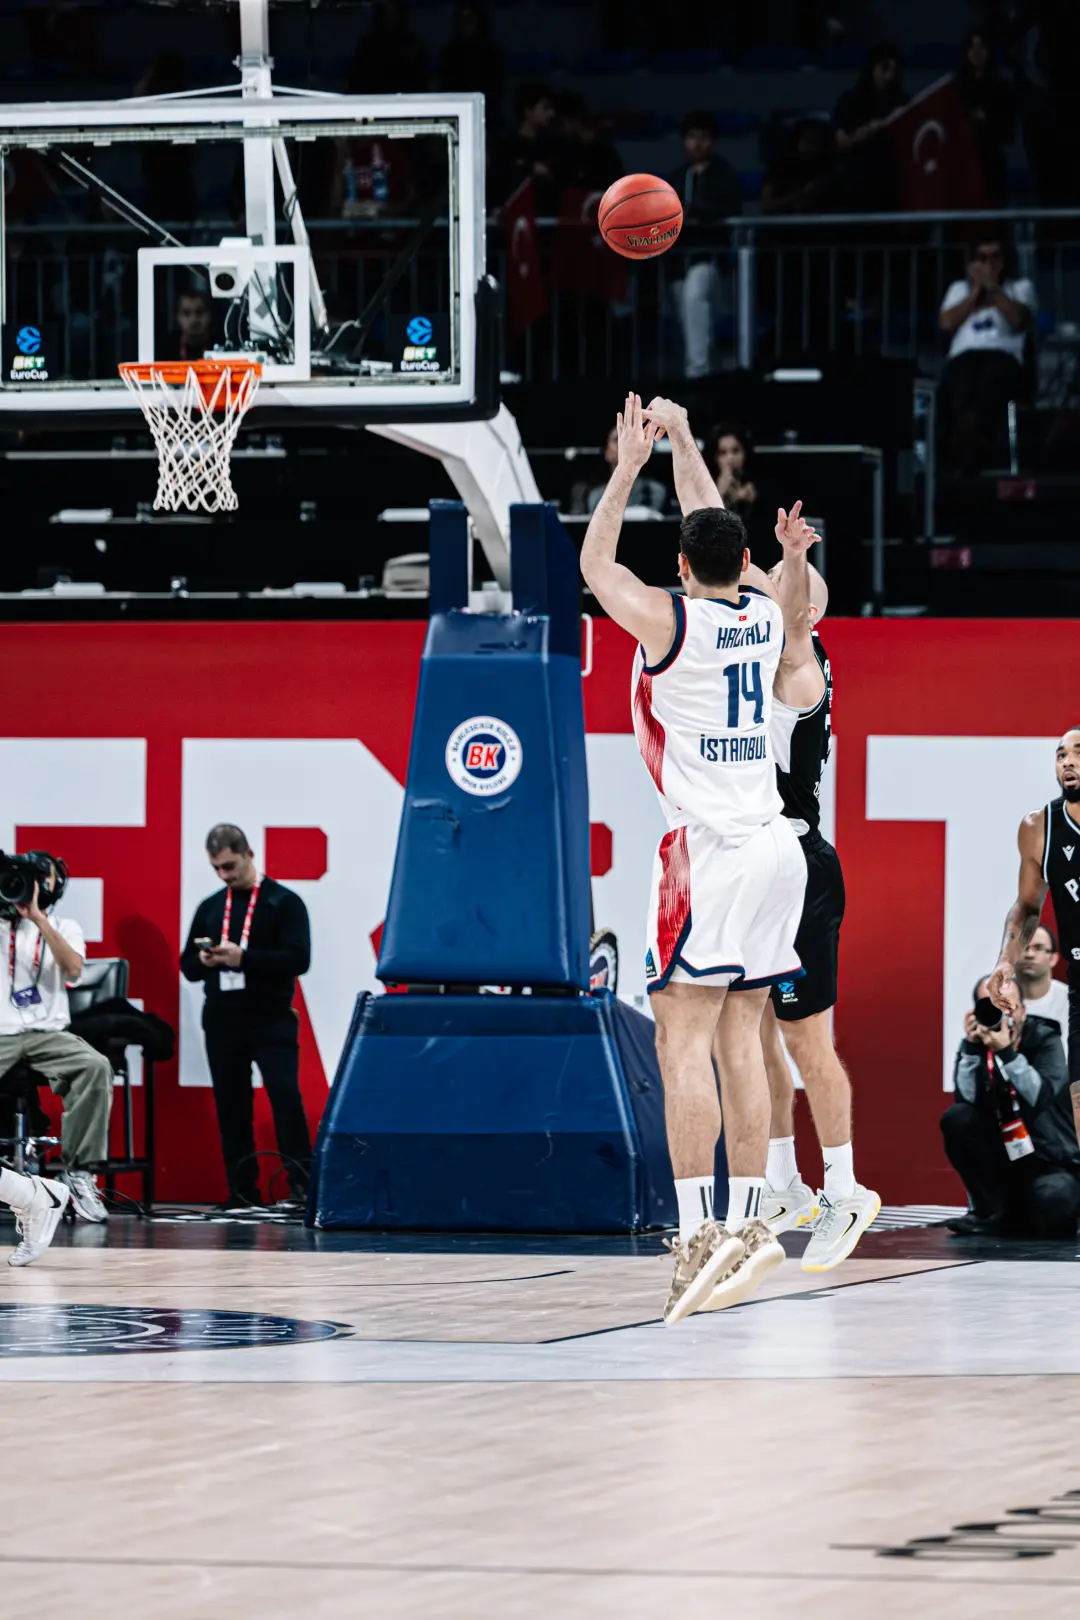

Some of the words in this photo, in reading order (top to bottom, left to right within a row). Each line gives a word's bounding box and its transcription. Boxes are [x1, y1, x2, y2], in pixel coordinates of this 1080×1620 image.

[626, 223, 679, 247] SPALDING
[10, 369, 49, 381] EuroCup
[400, 360, 440, 371] EuroCup
[723, 661, 765, 728] 14
[466, 742, 501, 770] BK
